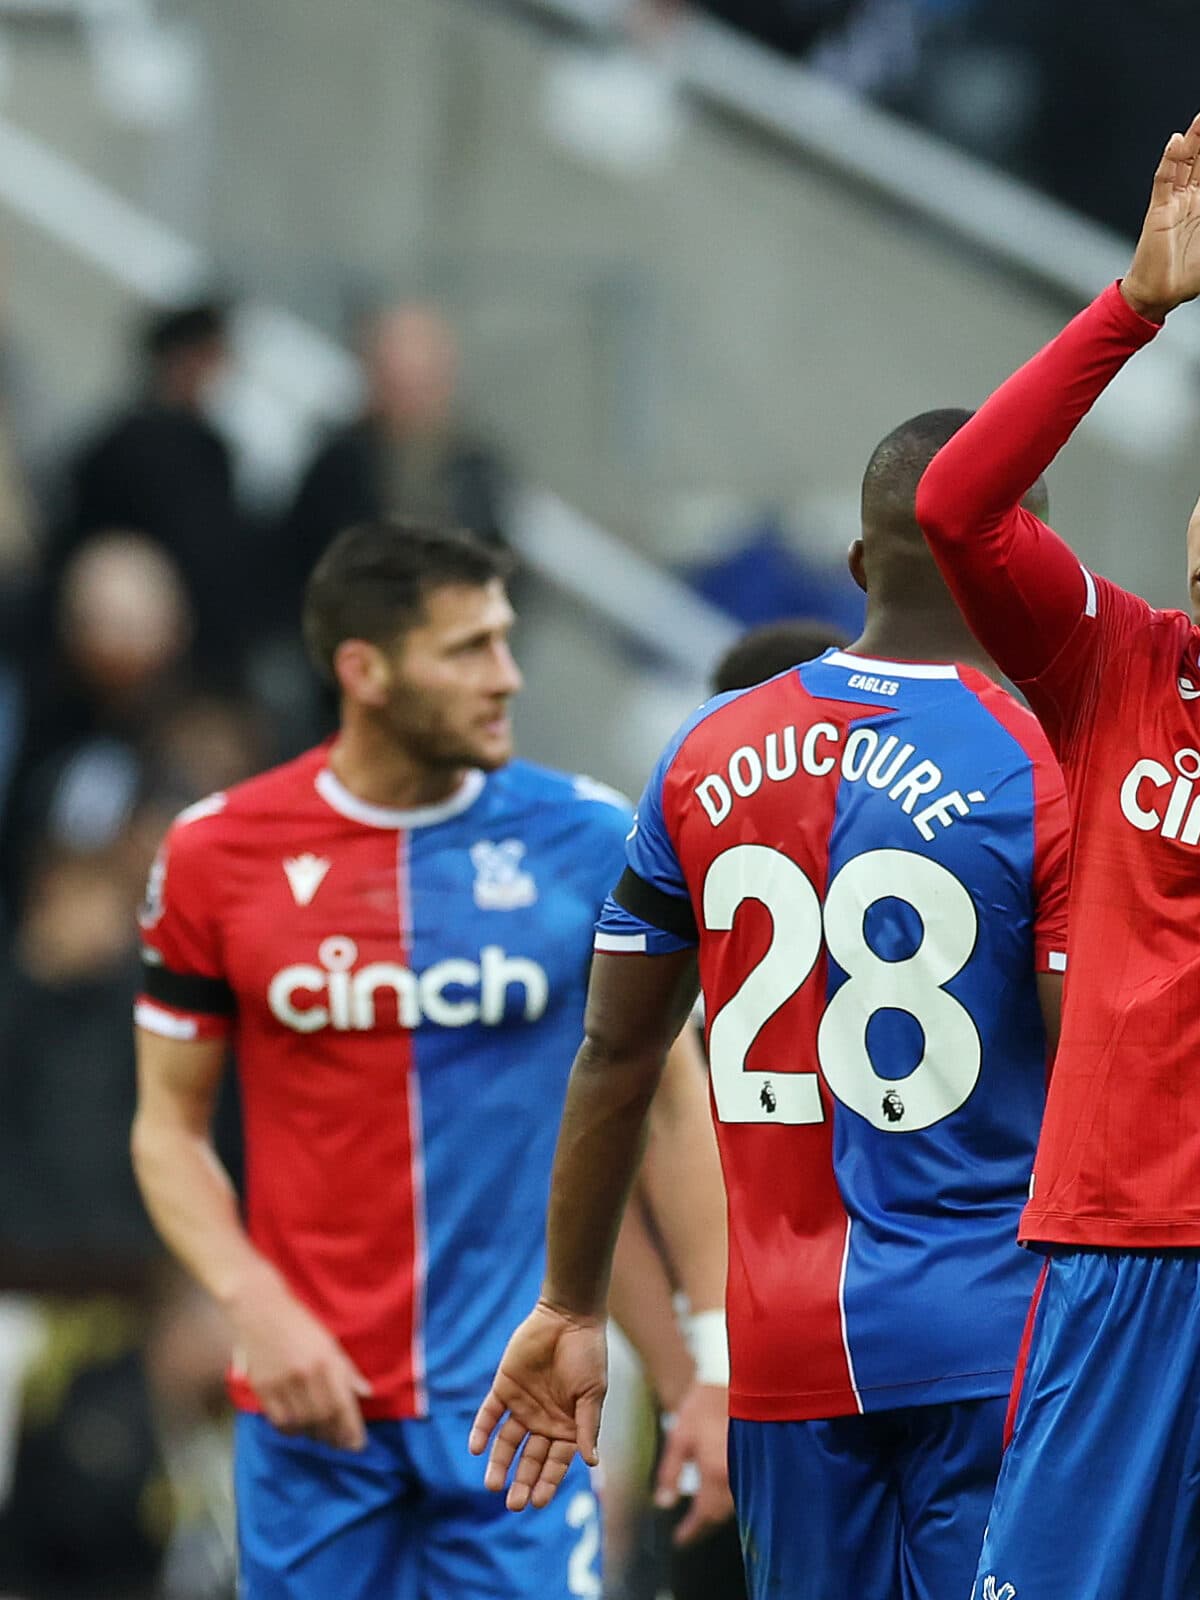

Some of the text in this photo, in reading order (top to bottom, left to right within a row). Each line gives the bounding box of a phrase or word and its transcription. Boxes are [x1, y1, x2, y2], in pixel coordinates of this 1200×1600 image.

[847, 674, 900, 696] EAGLES
[694, 721, 986, 842] DOUCOURÉ
[267, 934, 549, 1033] cinch
[702, 843, 982, 1132] 28
[565, 1491, 602, 1597] 2
